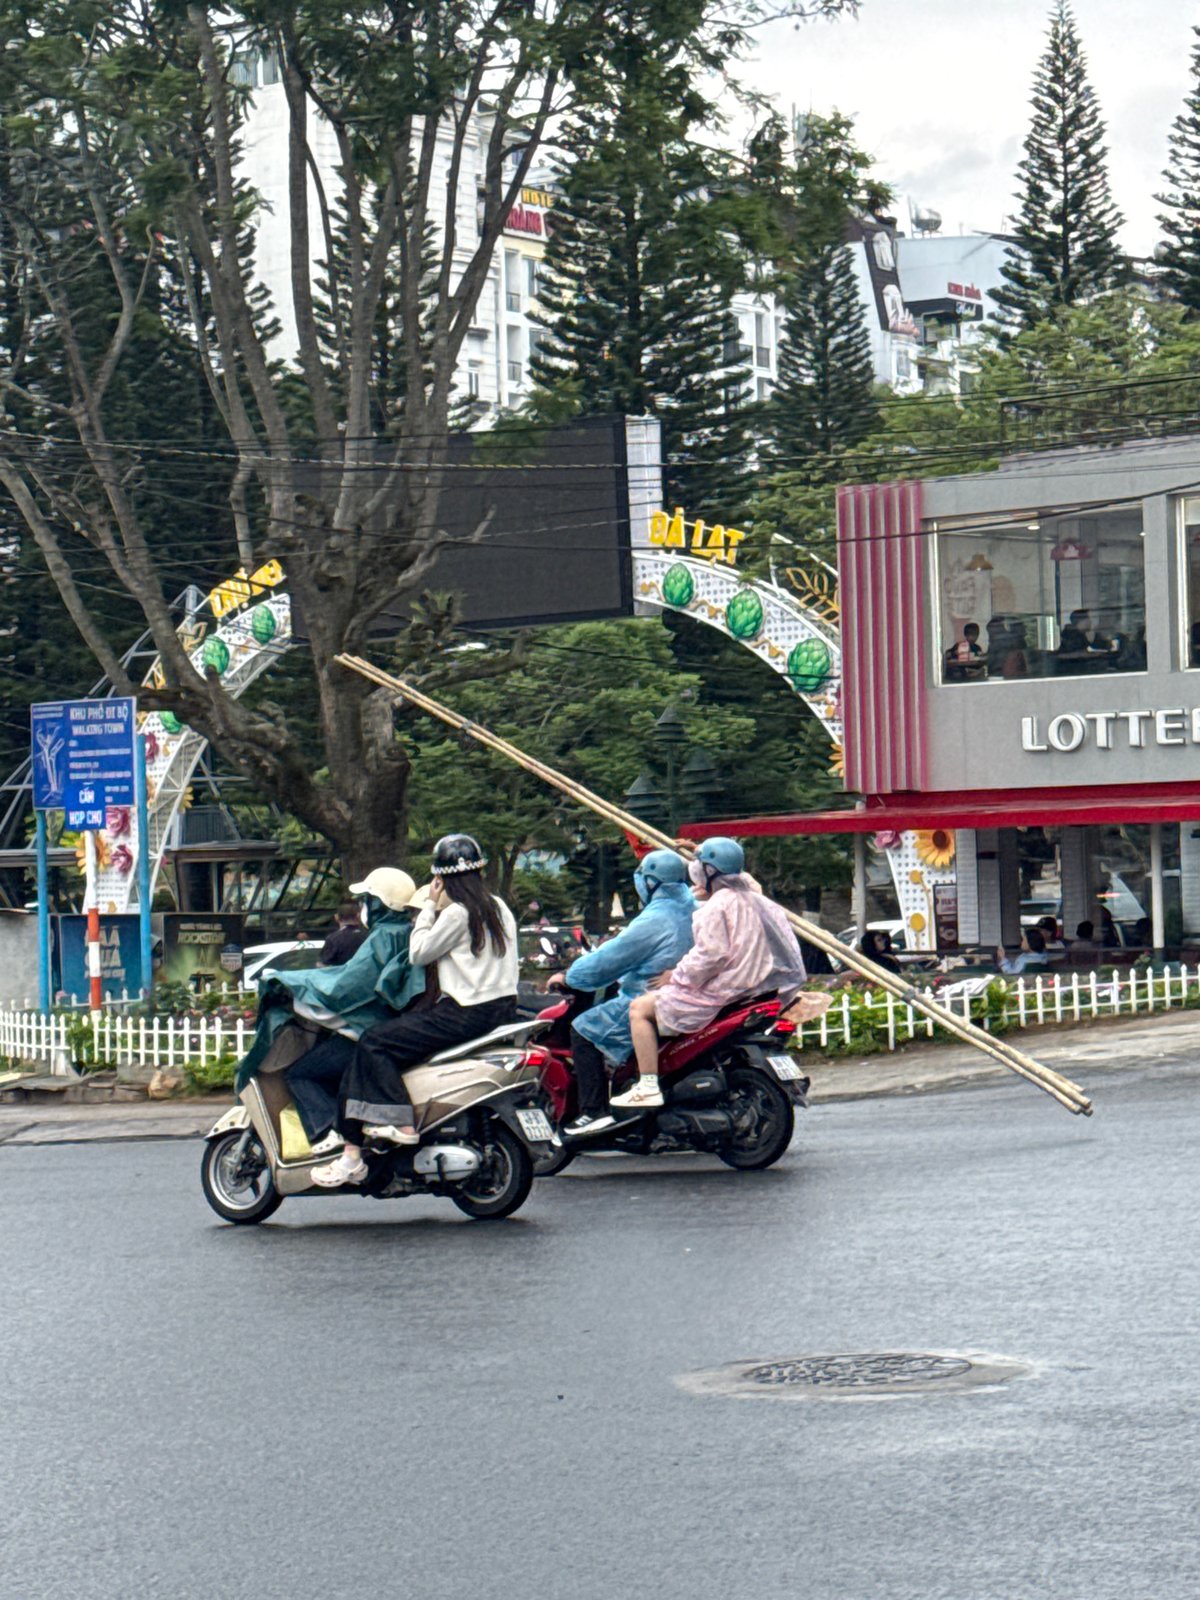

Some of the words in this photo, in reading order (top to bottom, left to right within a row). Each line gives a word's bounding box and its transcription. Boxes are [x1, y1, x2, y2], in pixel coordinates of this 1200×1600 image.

[70, 707, 86, 720] KHU
[87, 703, 104, 720] PHỐ
[117, 702, 129, 721] BỘ
[72, 724, 103, 736] WALKING
[104, 722, 125, 734] TOWN
[1021, 707, 1200, 752] LOTTE
[86, 809, 103, 827] CHỢ
